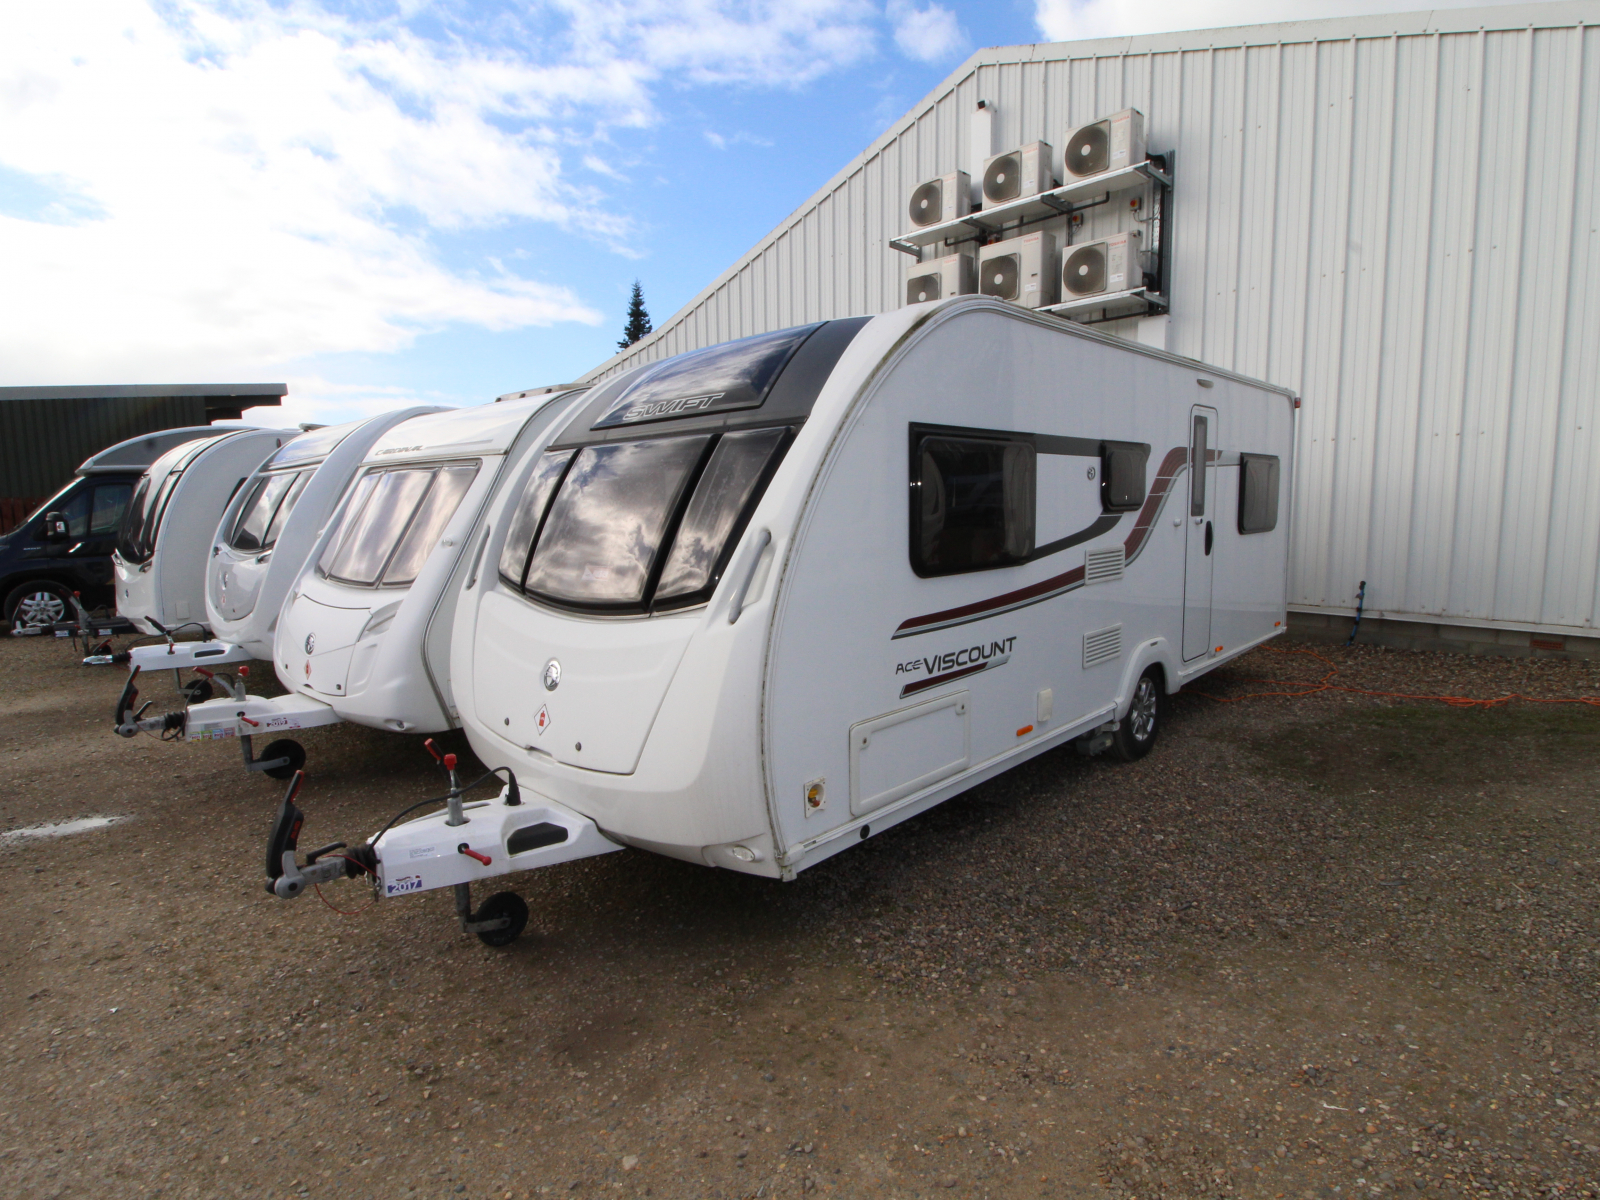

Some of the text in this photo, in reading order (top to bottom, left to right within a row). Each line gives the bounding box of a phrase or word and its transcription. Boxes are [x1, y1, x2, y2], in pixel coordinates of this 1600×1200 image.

[623, 392, 726, 420] SWIFT
[896, 636, 1017, 675] ACE VISCOUNT
[391, 881, 419, 892] 2017
